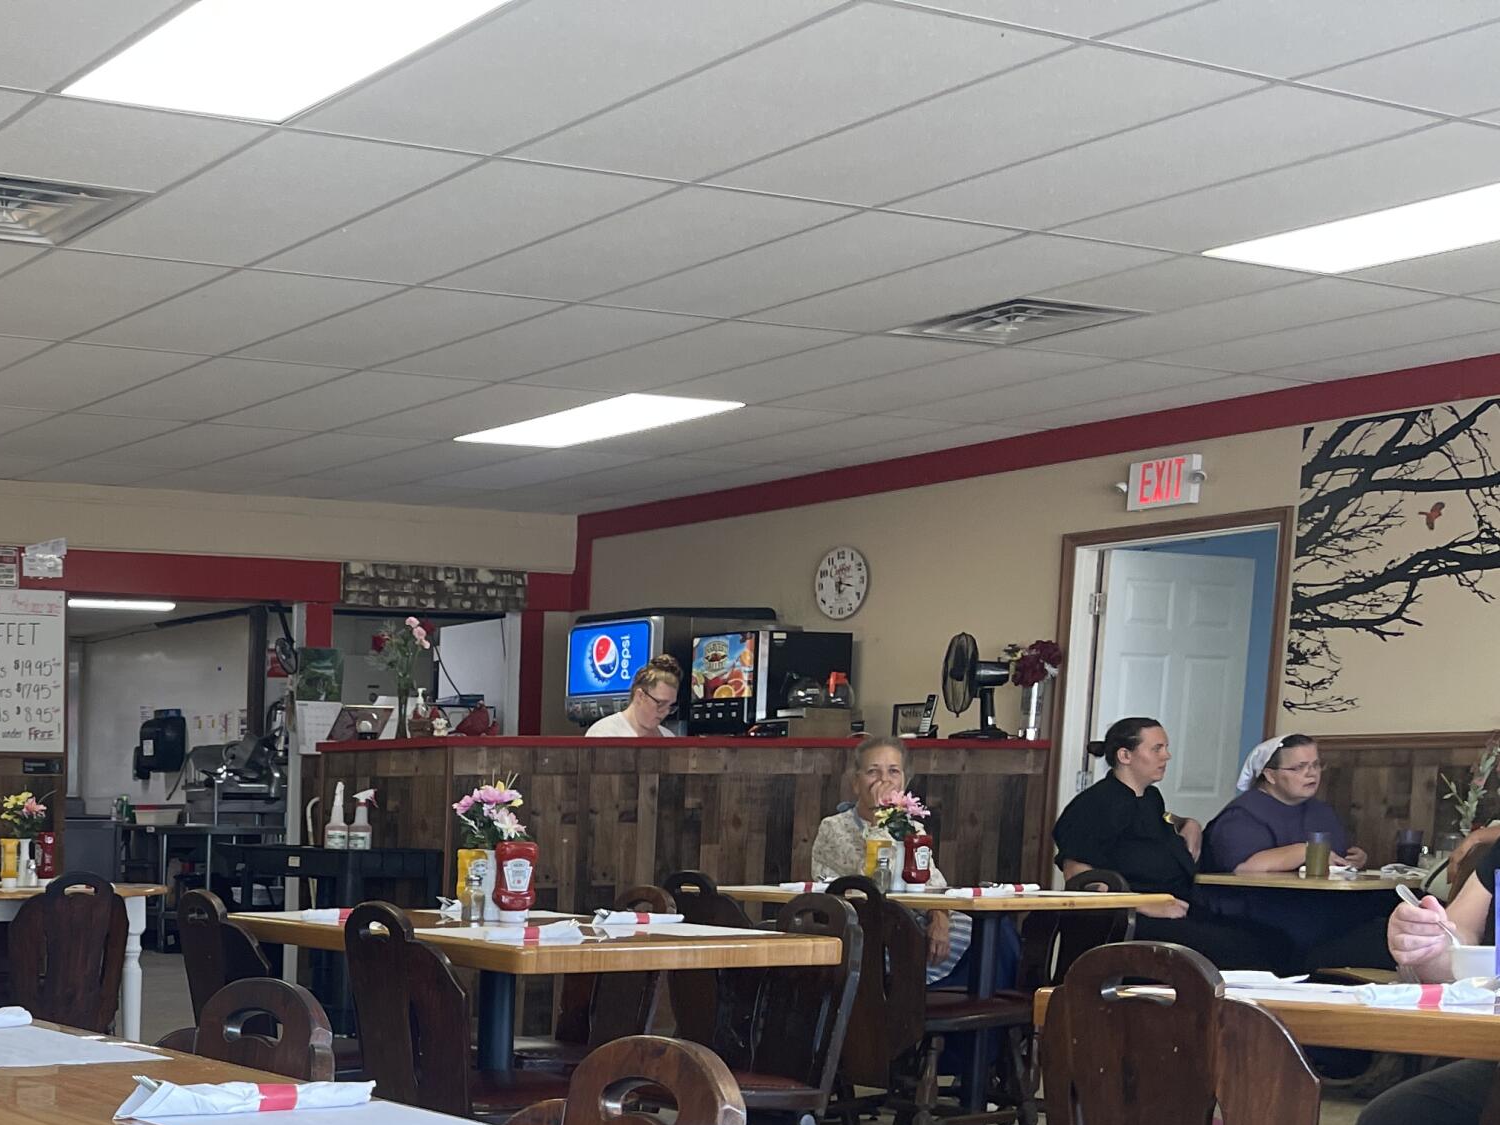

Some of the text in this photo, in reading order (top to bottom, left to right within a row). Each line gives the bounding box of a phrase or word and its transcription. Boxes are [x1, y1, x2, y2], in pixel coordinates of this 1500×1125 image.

[1139, 458, 1186, 504] EXIT
[620, 633, 632, 680] pepsi
[1, 727, 23, 739] under
